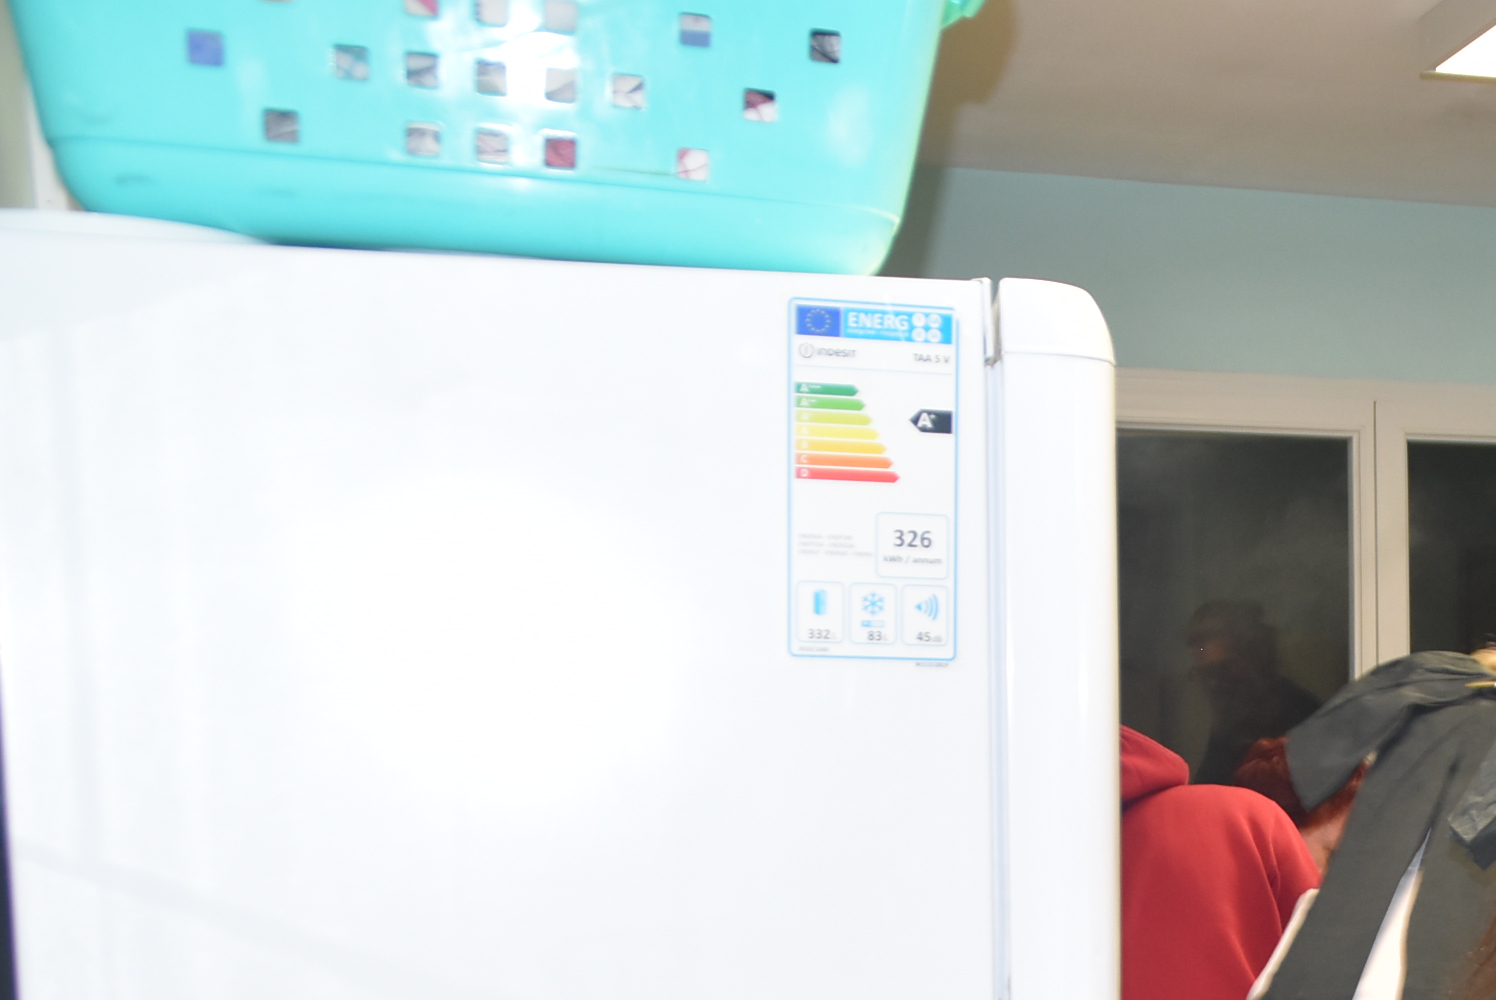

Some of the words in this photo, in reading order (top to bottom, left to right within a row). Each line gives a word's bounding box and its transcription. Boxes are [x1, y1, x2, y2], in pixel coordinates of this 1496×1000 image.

[847, 312, 909, 331] ENERG
[943, 355, 950, 364] V
[916, 412, 936, 428] A+
[800, 454, 808, 463] C
[801, 468, 809, 477] D
[893, 529, 933, 549] 326
